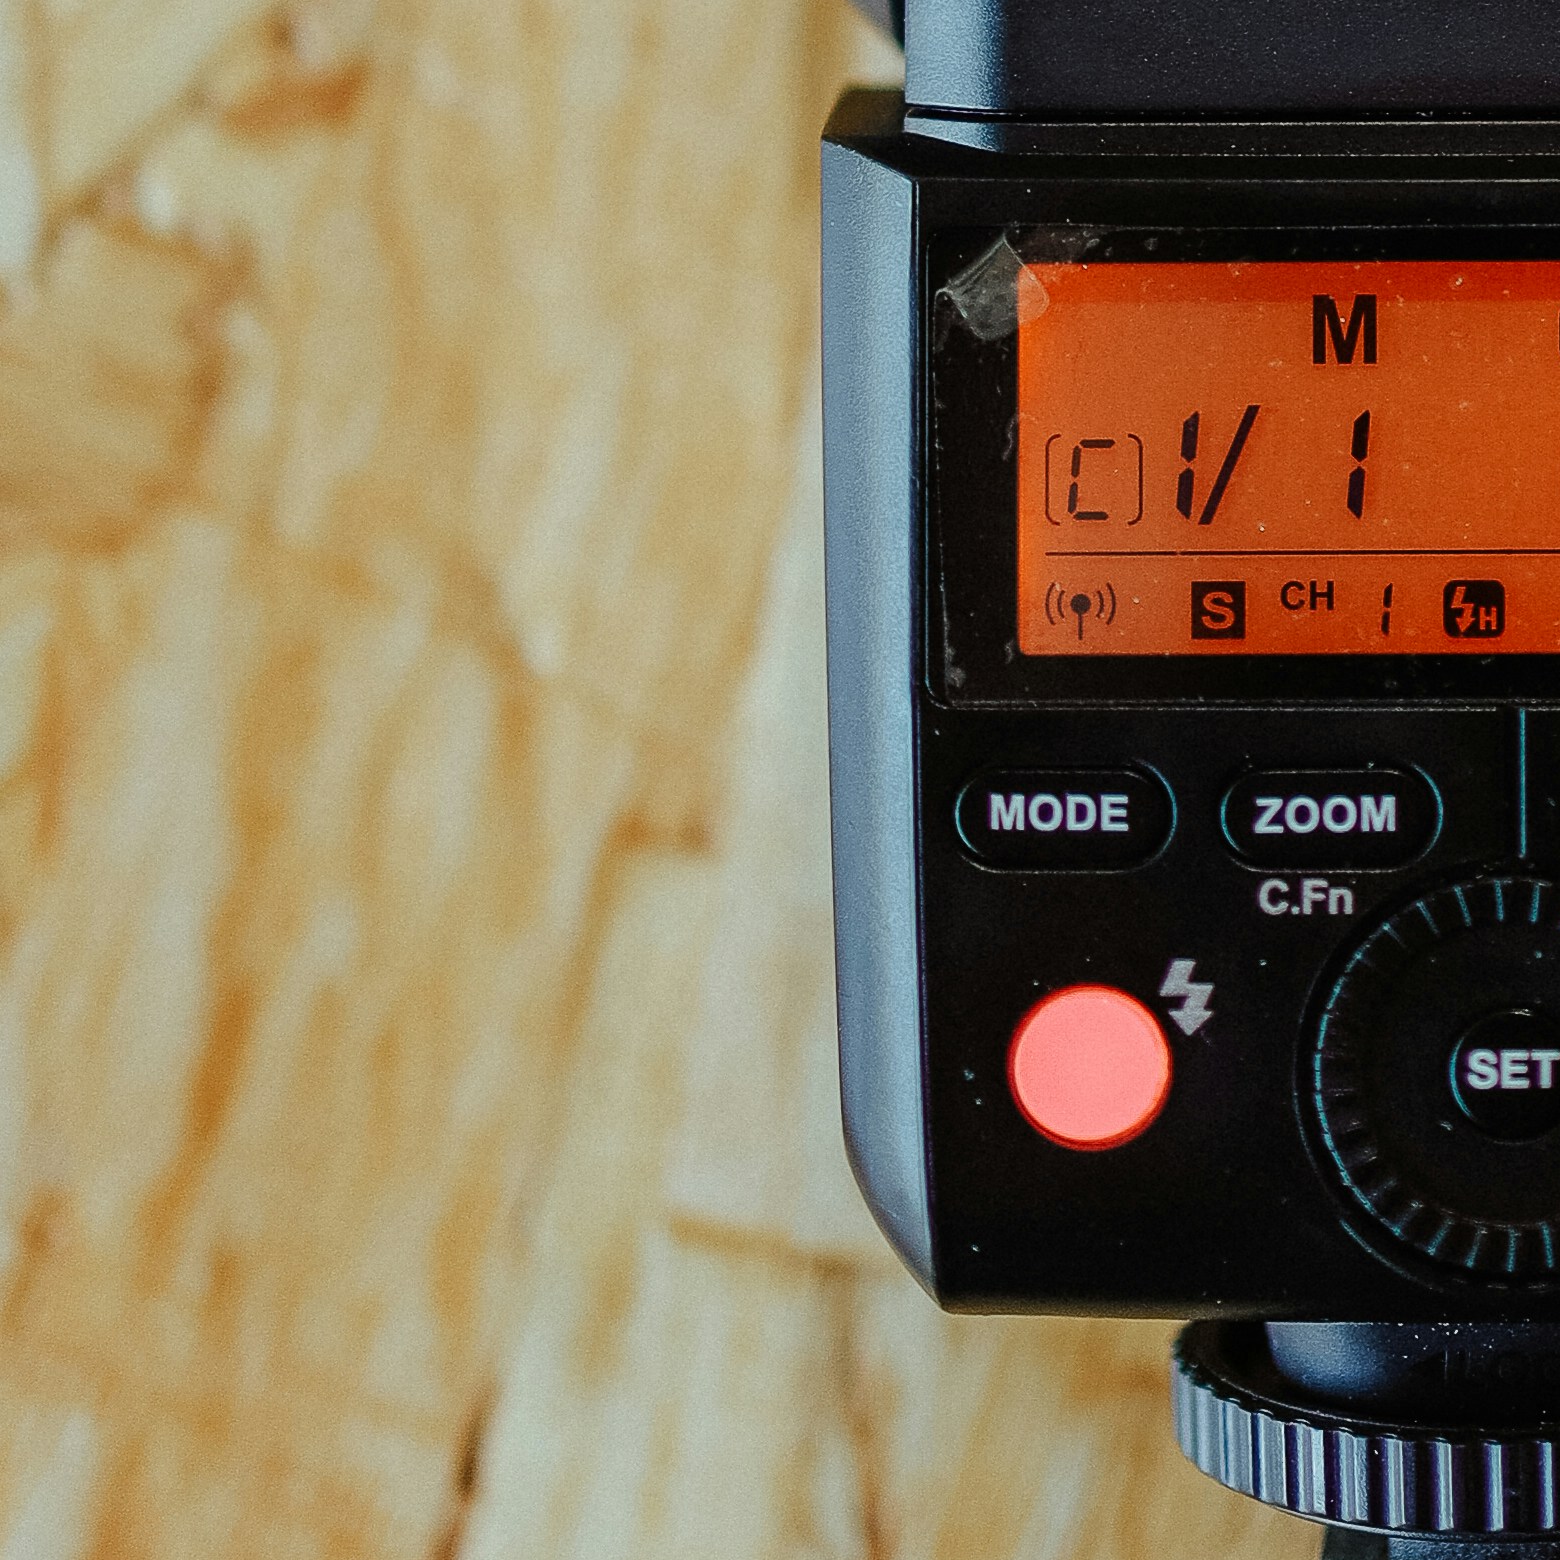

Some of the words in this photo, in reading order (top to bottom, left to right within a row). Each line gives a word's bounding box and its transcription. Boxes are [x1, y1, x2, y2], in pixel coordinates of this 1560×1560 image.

[1312, 294, 1378, 365] M
[1201, 591, 1236, 630] S
[1279, 580, 1335, 612] CH
[989, 793, 1129, 832] MODE
[1253, 795, 1397, 834] ZOOM
[1257, 878, 1354, 915] C.Fn
